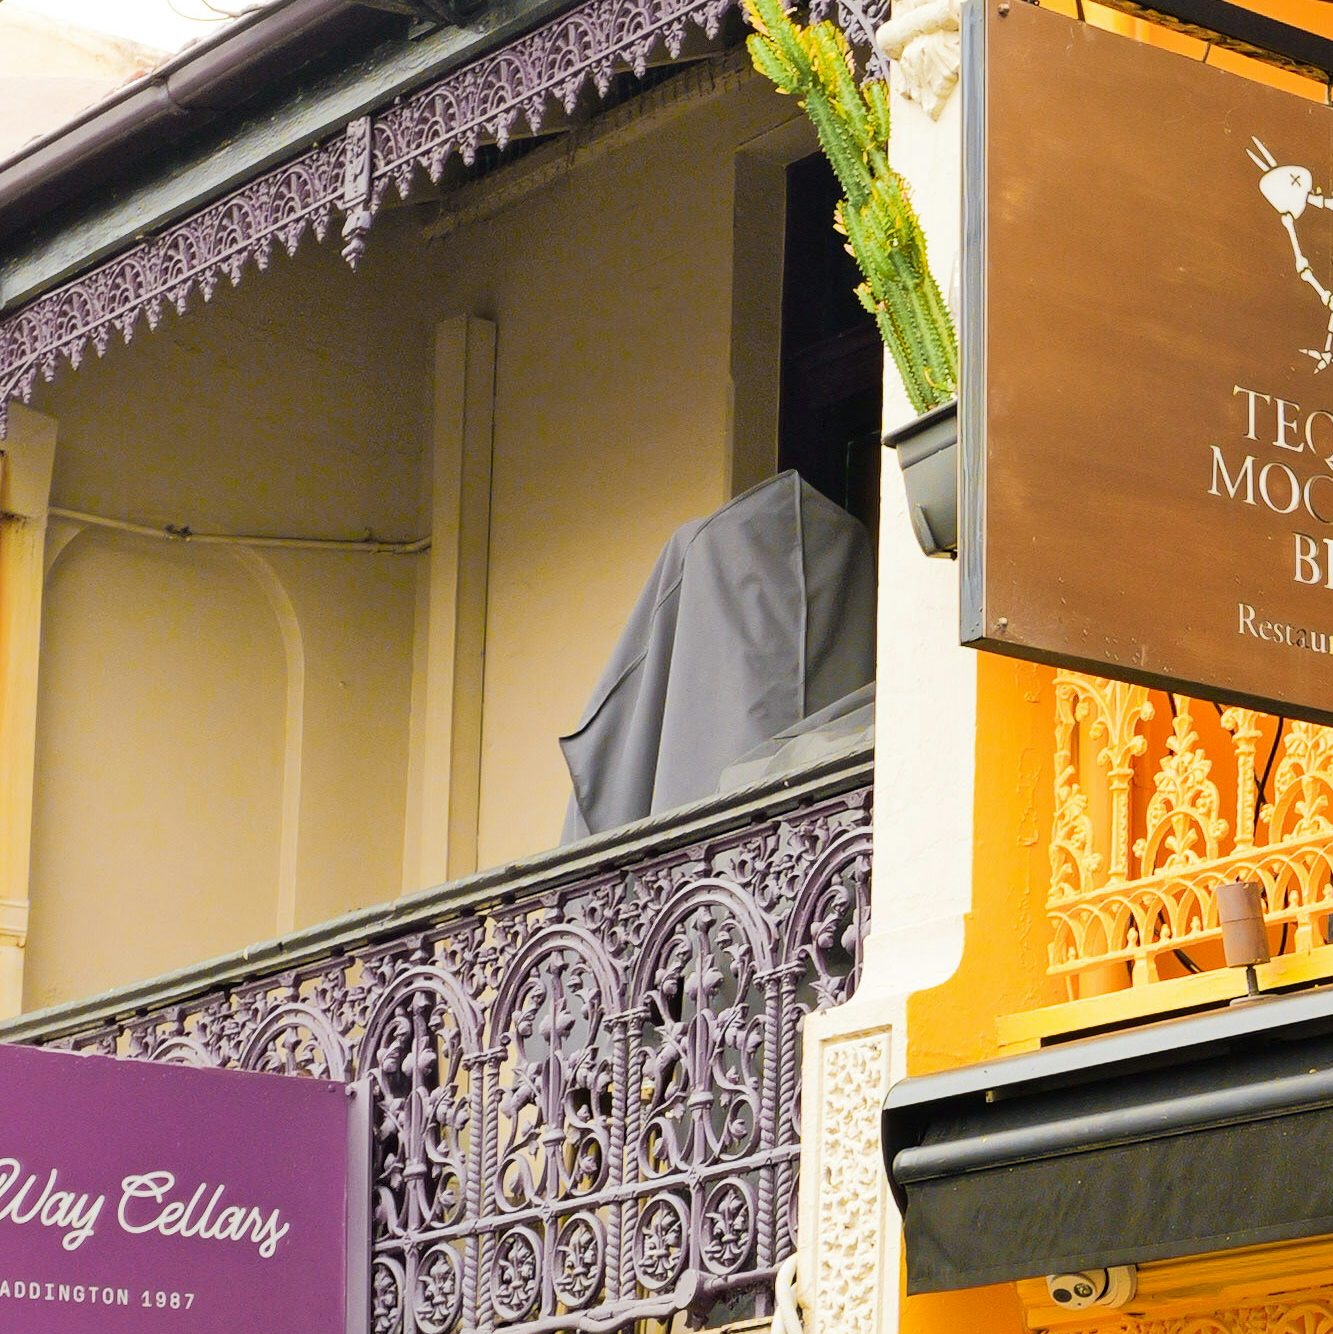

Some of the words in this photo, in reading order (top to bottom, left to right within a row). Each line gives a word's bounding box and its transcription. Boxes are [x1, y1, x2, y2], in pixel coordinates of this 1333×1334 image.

[117, 1170, 290, 1259] Cellars
[0, 1279, 129, 1305] ADDINGTON
[141, 1290, 195, 1310] 1987
